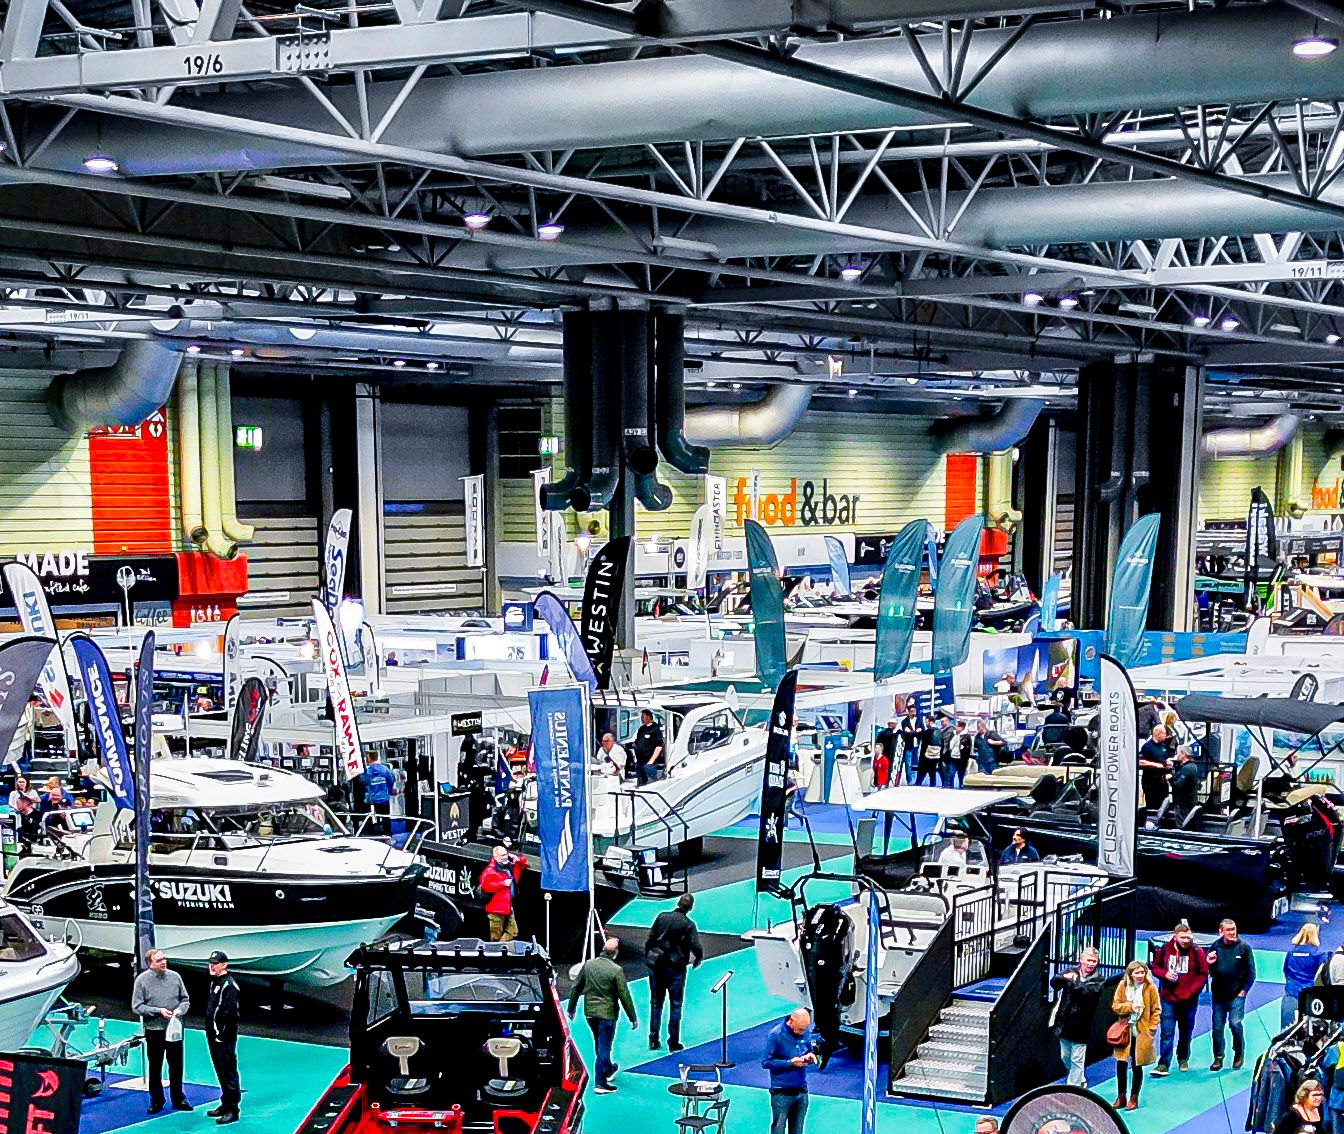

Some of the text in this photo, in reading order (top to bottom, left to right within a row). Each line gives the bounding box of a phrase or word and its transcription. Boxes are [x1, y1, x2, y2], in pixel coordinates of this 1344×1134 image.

[183, 54, 224, 75] 19/6
[1291, 266, 1323, 278] 19/11
[800, 479, 820, 527] &
[822, 477, 861, 527] bar
[16, 552, 90, 576] MADE
[587, 561, 614, 654] WESTIN
[1108, 692, 1120, 731] BOATS
[1107, 736, 1119, 781] POWER
[159, 881, 233, 903] SUZUKI
